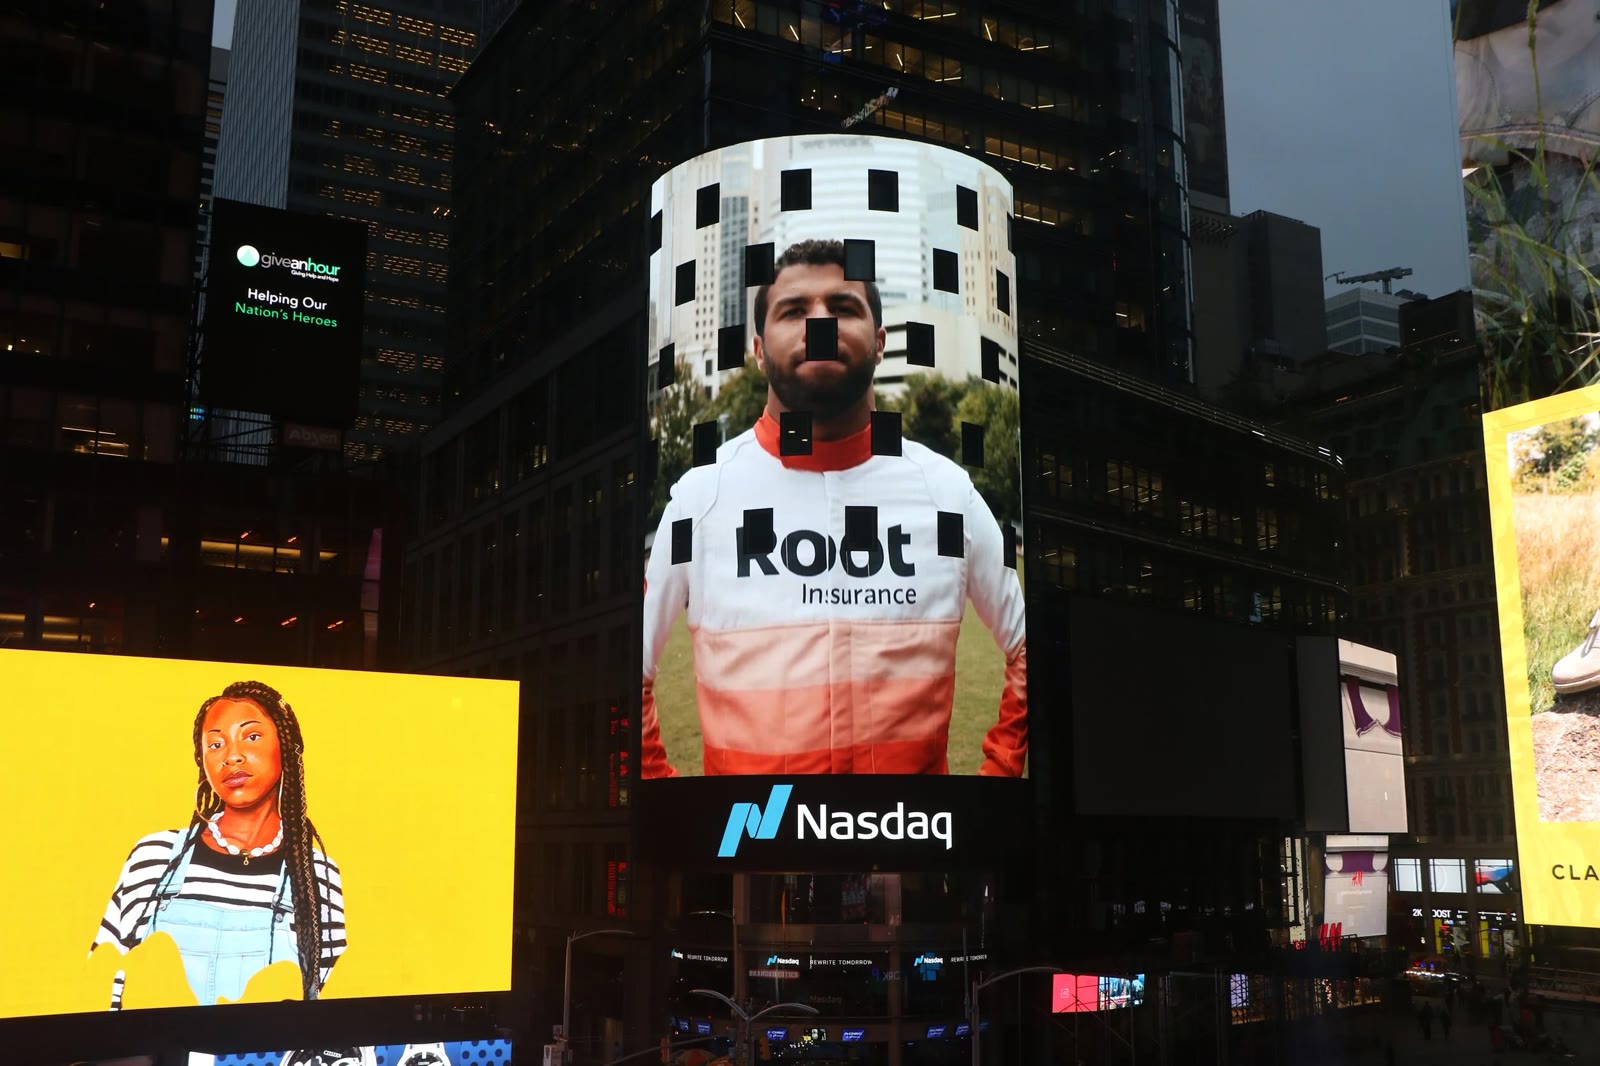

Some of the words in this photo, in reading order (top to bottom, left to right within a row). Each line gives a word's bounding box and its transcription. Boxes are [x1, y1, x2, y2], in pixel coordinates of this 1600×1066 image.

[248, 288, 299, 309] Helping
[302, 297, 327, 310] Our
[235, 302, 289, 320] Nation's
[293, 311, 338, 327] Heroes
[797, 802, 953, 850] Nasdaq
[1552, 864, 1600, 881] CLA
[1412, 909, 1423, 917] 2K
[1431, 909, 1451, 918] OOST
[777, 957, 800, 966] Nasdaq
